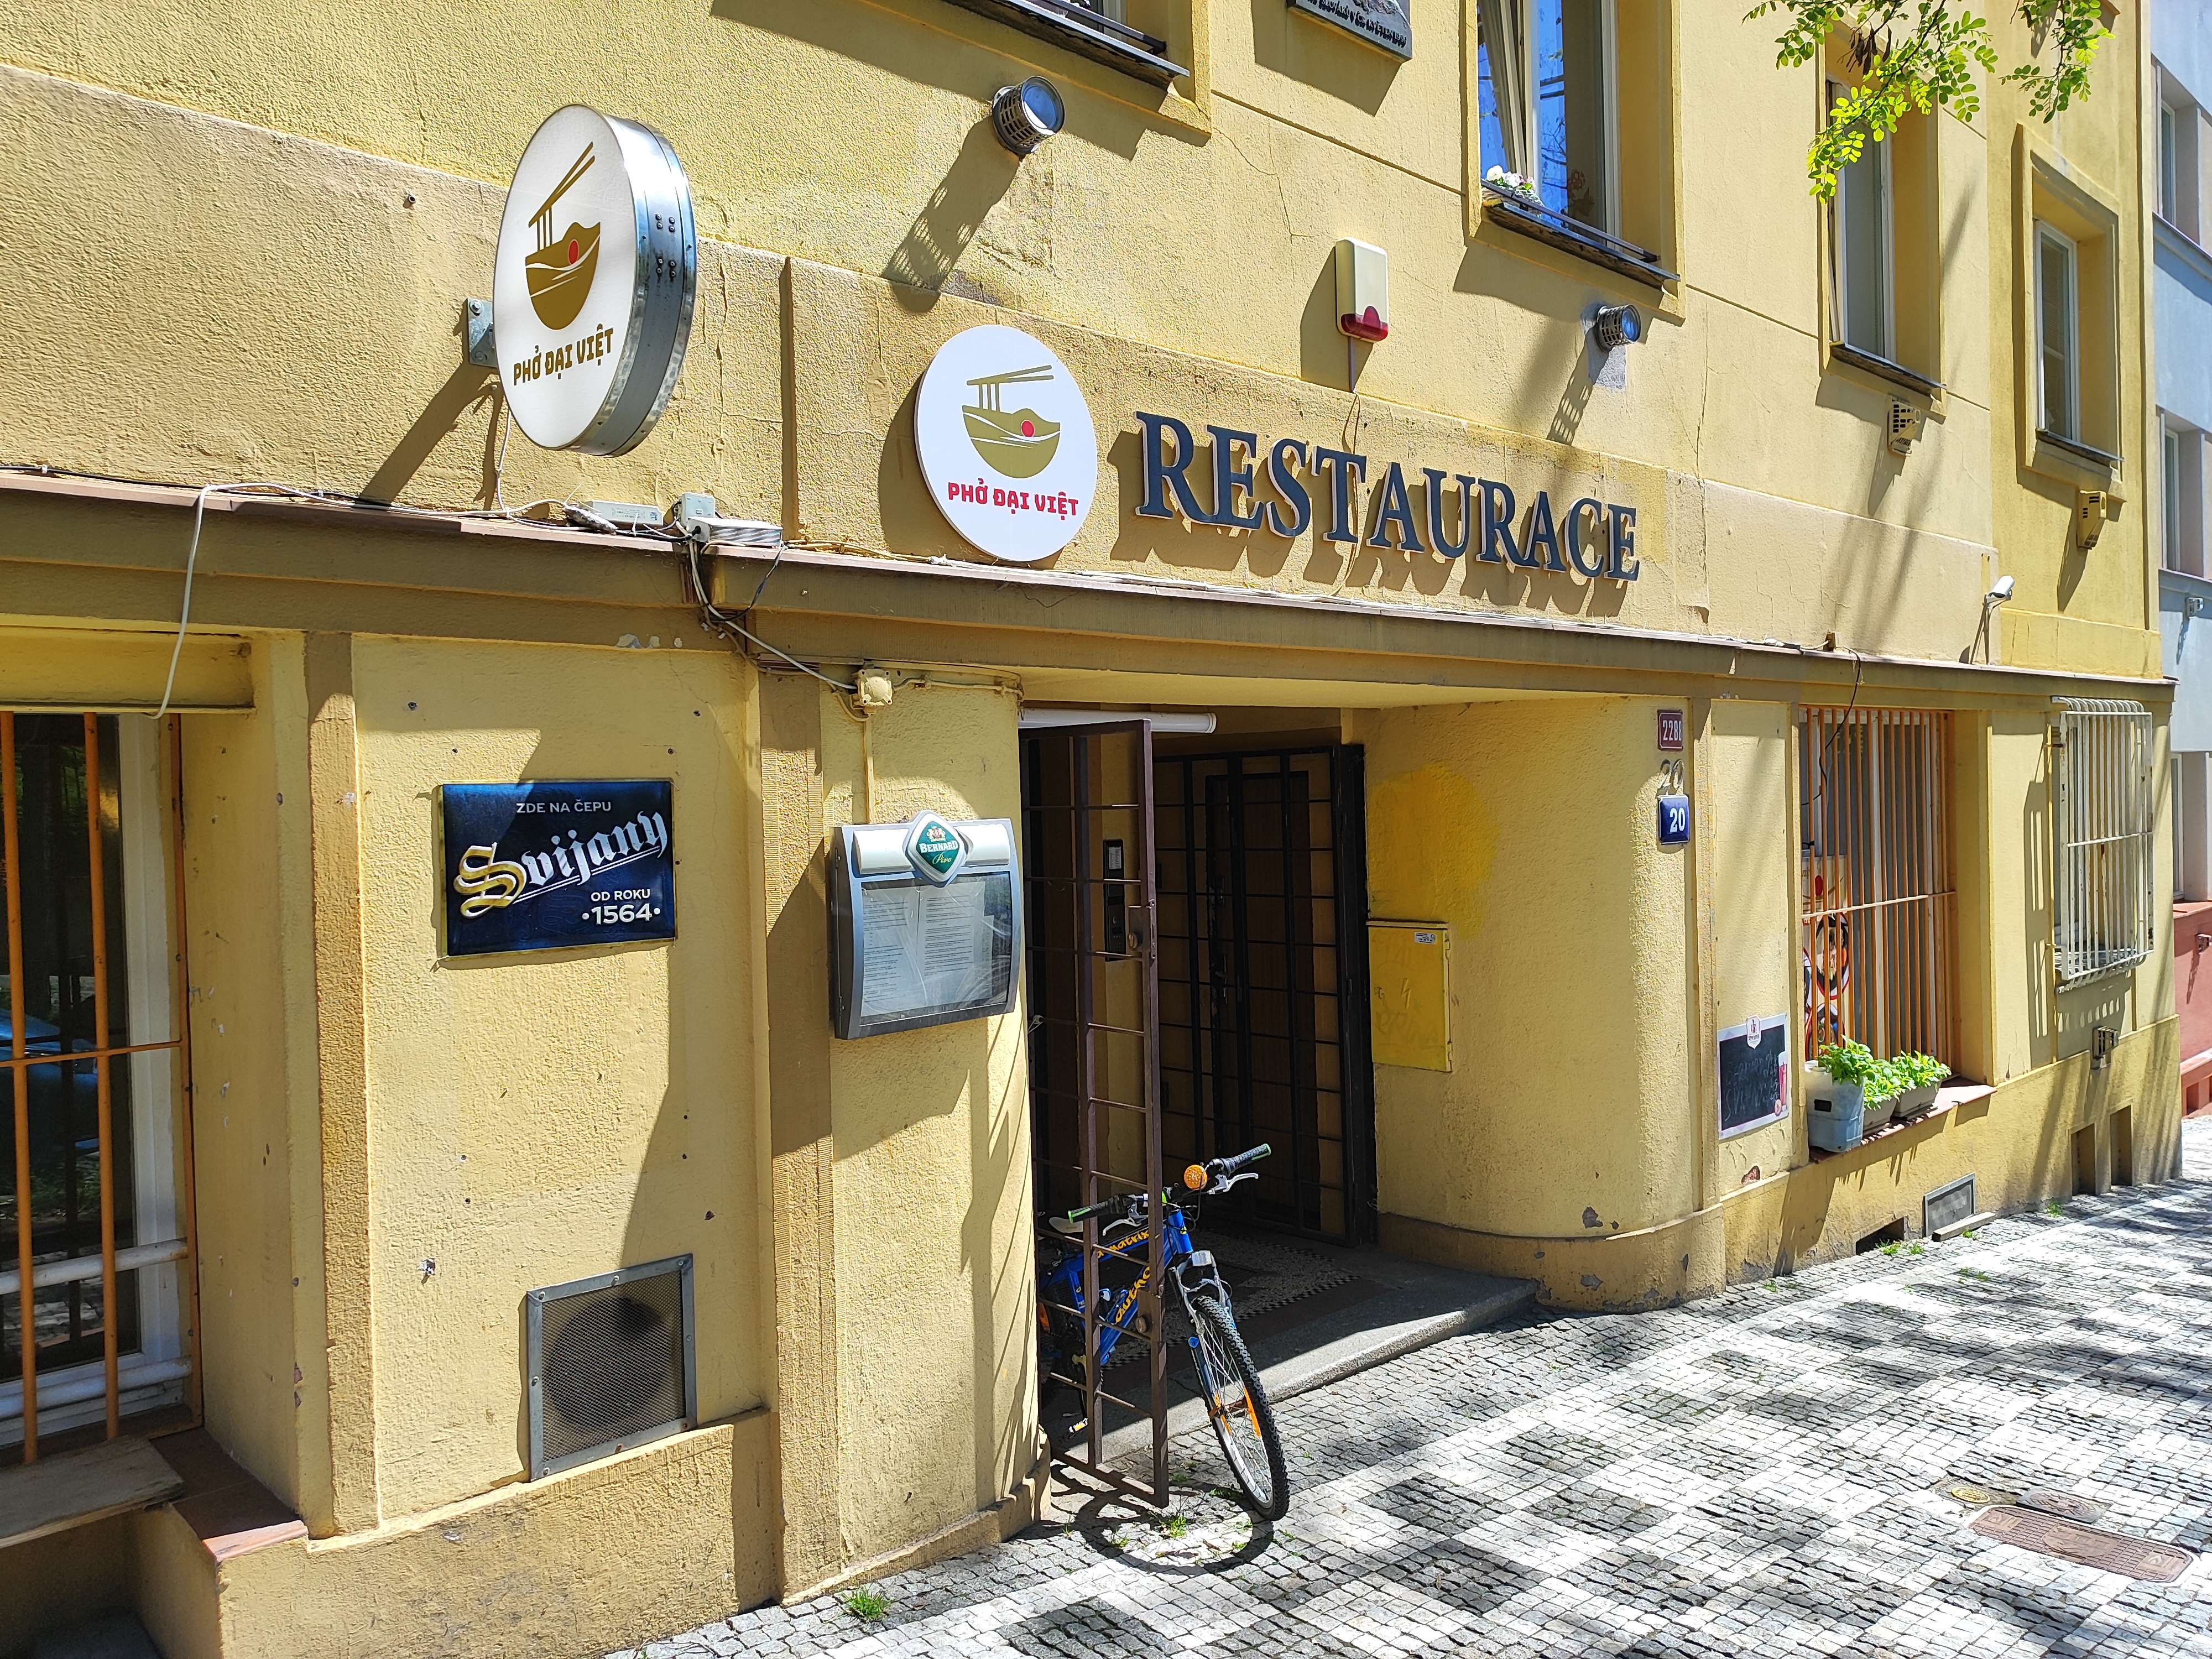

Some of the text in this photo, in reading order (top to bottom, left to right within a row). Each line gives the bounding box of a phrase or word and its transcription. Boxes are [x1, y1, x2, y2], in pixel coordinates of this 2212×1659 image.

[514, 323, 614, 386] PHỞ ĐẠI VIỆT
[948, 478, 1078, 520] PHỞ ĐẠI VIỆT
[1132, 410, 1640, 582] RESTAURACE
[1662, 719, 1682, 741] 2288
[516, 799, 612, 813] ZDE NA ČEPU
[1670, 807, 1686, 833] 20
[453, 810, 667, 919] Svijany
[591, 889, 650, 902] OD ROKU
[1115, 1266, 1151, 1323] autho
